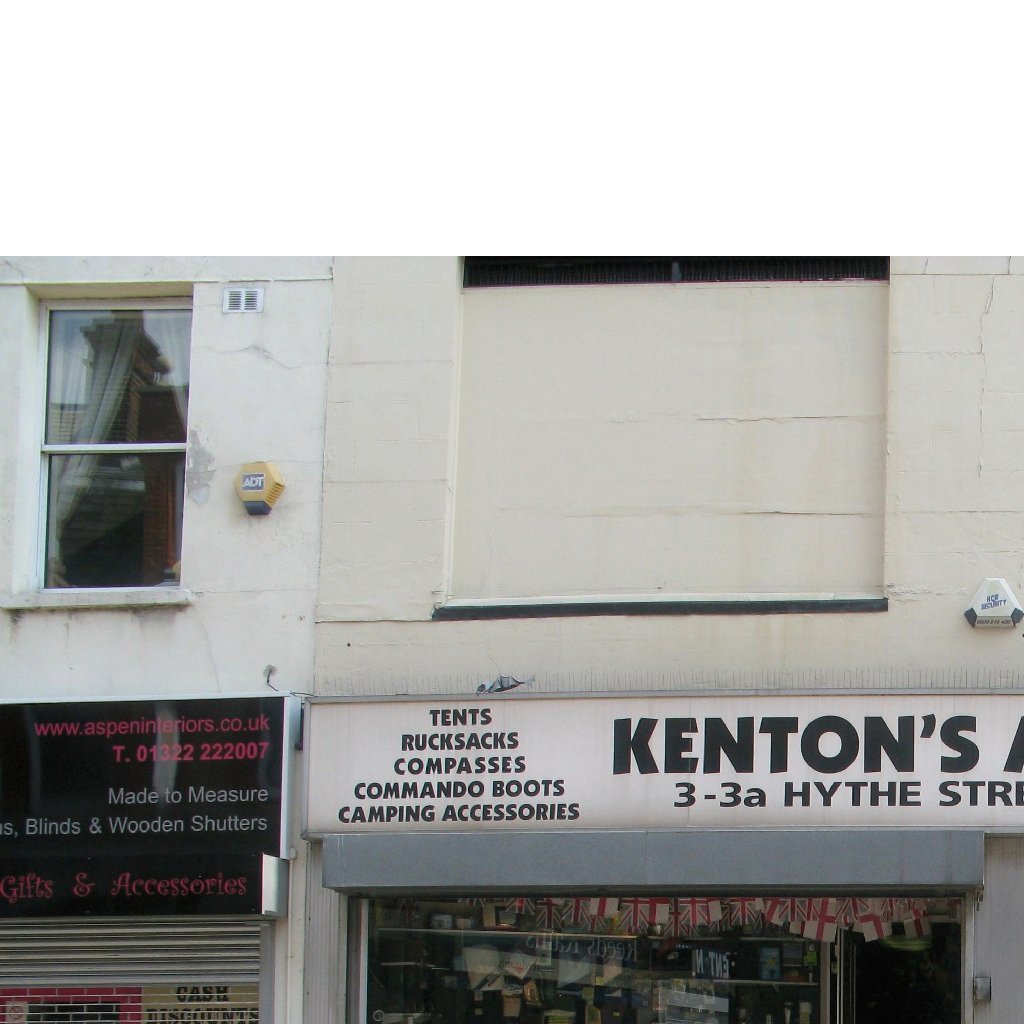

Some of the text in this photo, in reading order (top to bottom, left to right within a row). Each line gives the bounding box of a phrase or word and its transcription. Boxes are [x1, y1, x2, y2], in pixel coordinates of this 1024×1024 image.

[242, 476, 264, 488] ADT
[34, 714, 270, 738] www.aspeninteriors.co.uk
[430, 709, 492, 726] TENTS
[402, 732, 518, 751] RUCKSACKS
[613, 714, 979, 774] KENTON'S
[112, 742, 270, 763] T. 01322 222007
[394, 756, 525, 775] COMPASSES
[108, 786, 269, 805] Made to Measure
[355, 780, 564, 799] COMMANDO BOOTS
[784, 781, 922, 808] HYTHE
[339, 803, 579, 823] CAMPING ACCESSORIES
[26, 818, 81, 836] Blinds
[89, 818, 102, 834] &
[109, 816, 184, 834] Wooden
[191, 815, 268, 832] Shutters
[0, 872, 248, 903] Gifts & Accessories
[176, 986, 229, 1002] CASH
